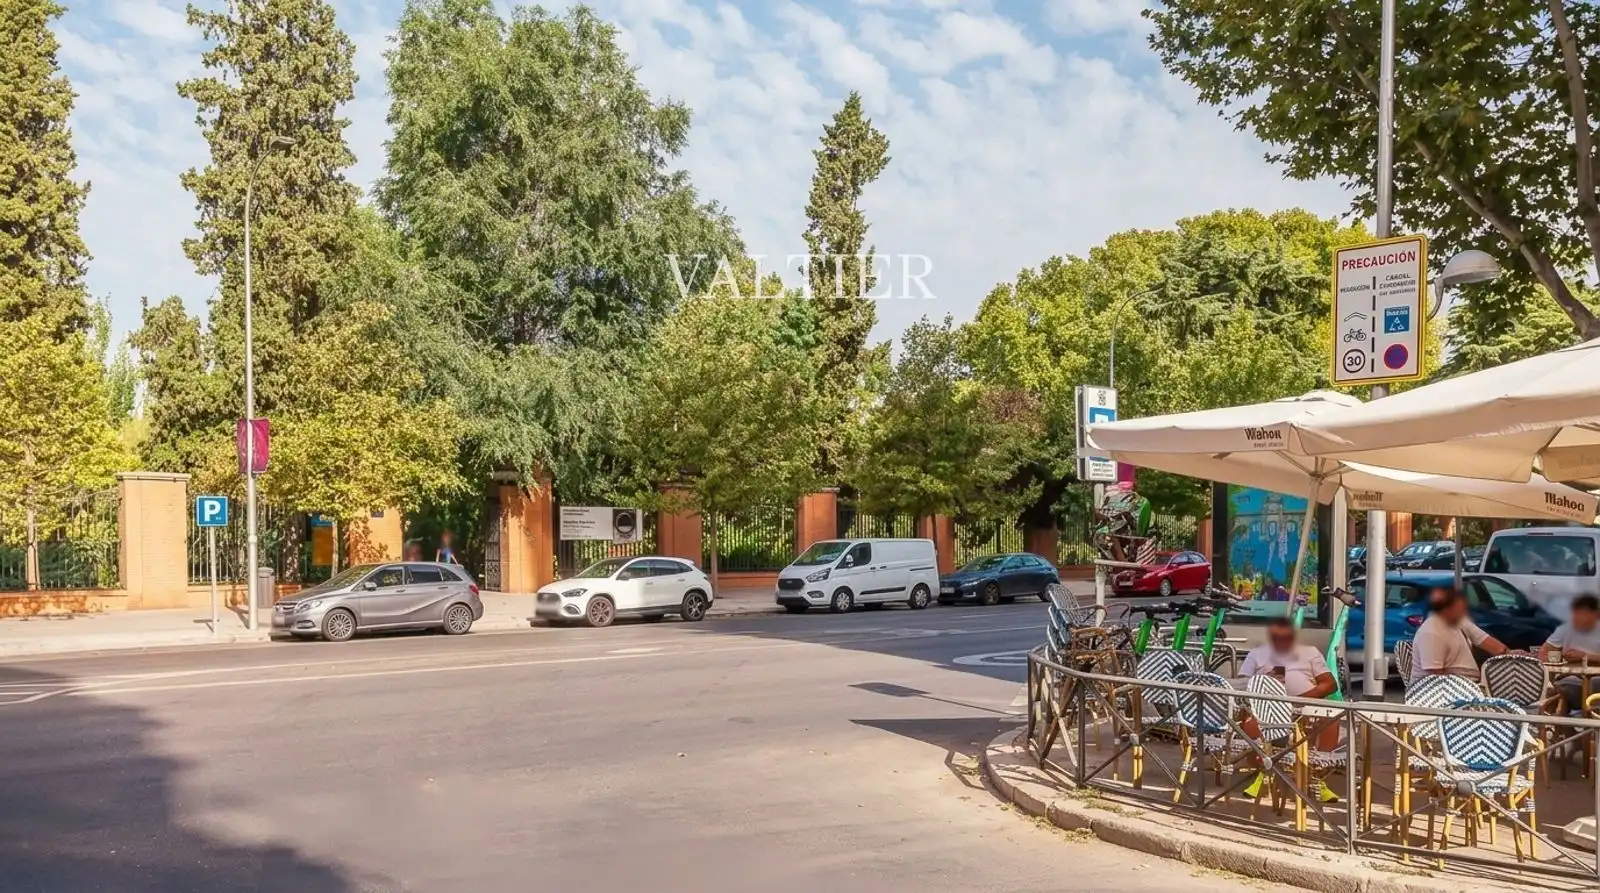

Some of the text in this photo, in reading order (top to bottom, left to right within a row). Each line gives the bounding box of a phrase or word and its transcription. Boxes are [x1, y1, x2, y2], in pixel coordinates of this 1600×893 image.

[1342, 250, 1416, 270] PRECAUCIÓN
[1347, 355, 1362, 366] 30
[204, 500, 221, 521] P
